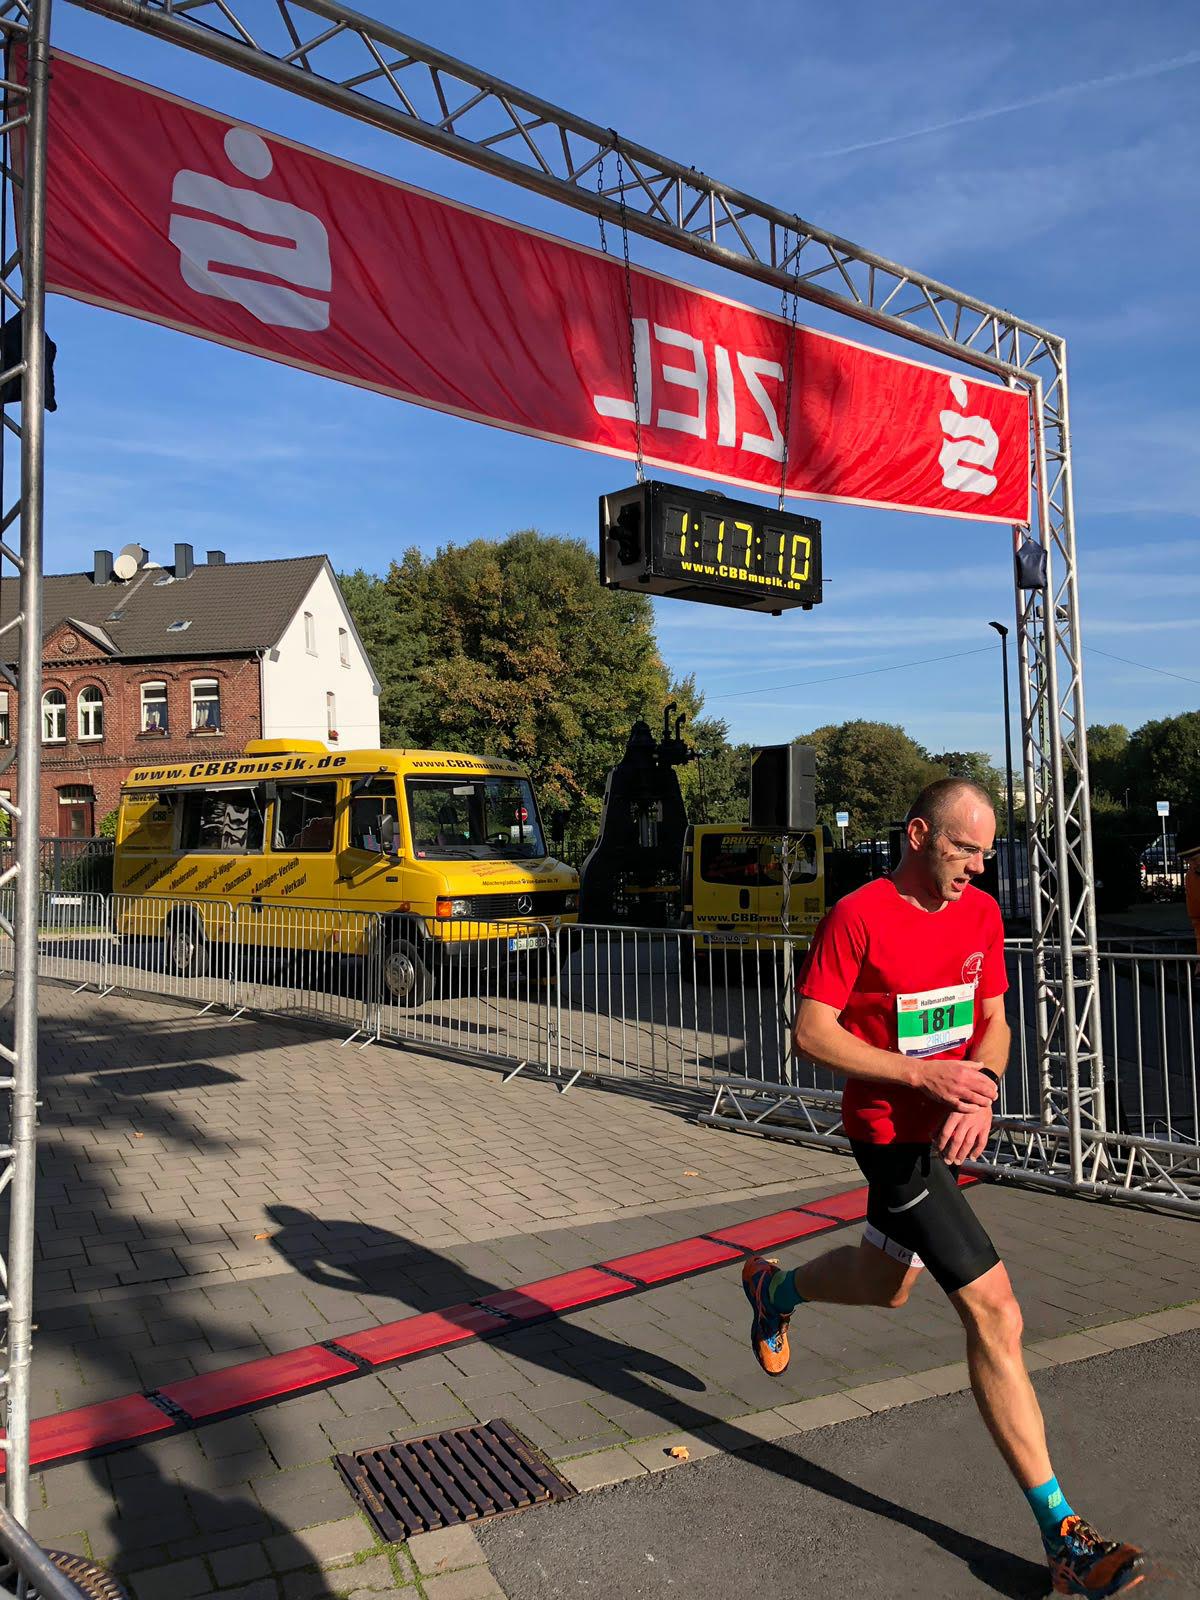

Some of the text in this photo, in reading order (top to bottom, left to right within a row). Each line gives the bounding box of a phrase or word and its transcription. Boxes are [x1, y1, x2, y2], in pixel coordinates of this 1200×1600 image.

[680, 512, 811, 581] 1:17:10
[680, 561, 801, 590] www.CBBmusik.de
[134, 756, 347, 781] www.CBBmusik.de
[412, 759, 519, 773] www.CBBmusik.de
[224, 867, 253, 893] Tanzmusik
[283, 873, 308, 895] Verkauf
[921, 996, 956, 1007] Halbmarathon
[918, 1004, 956, 1034] 181
